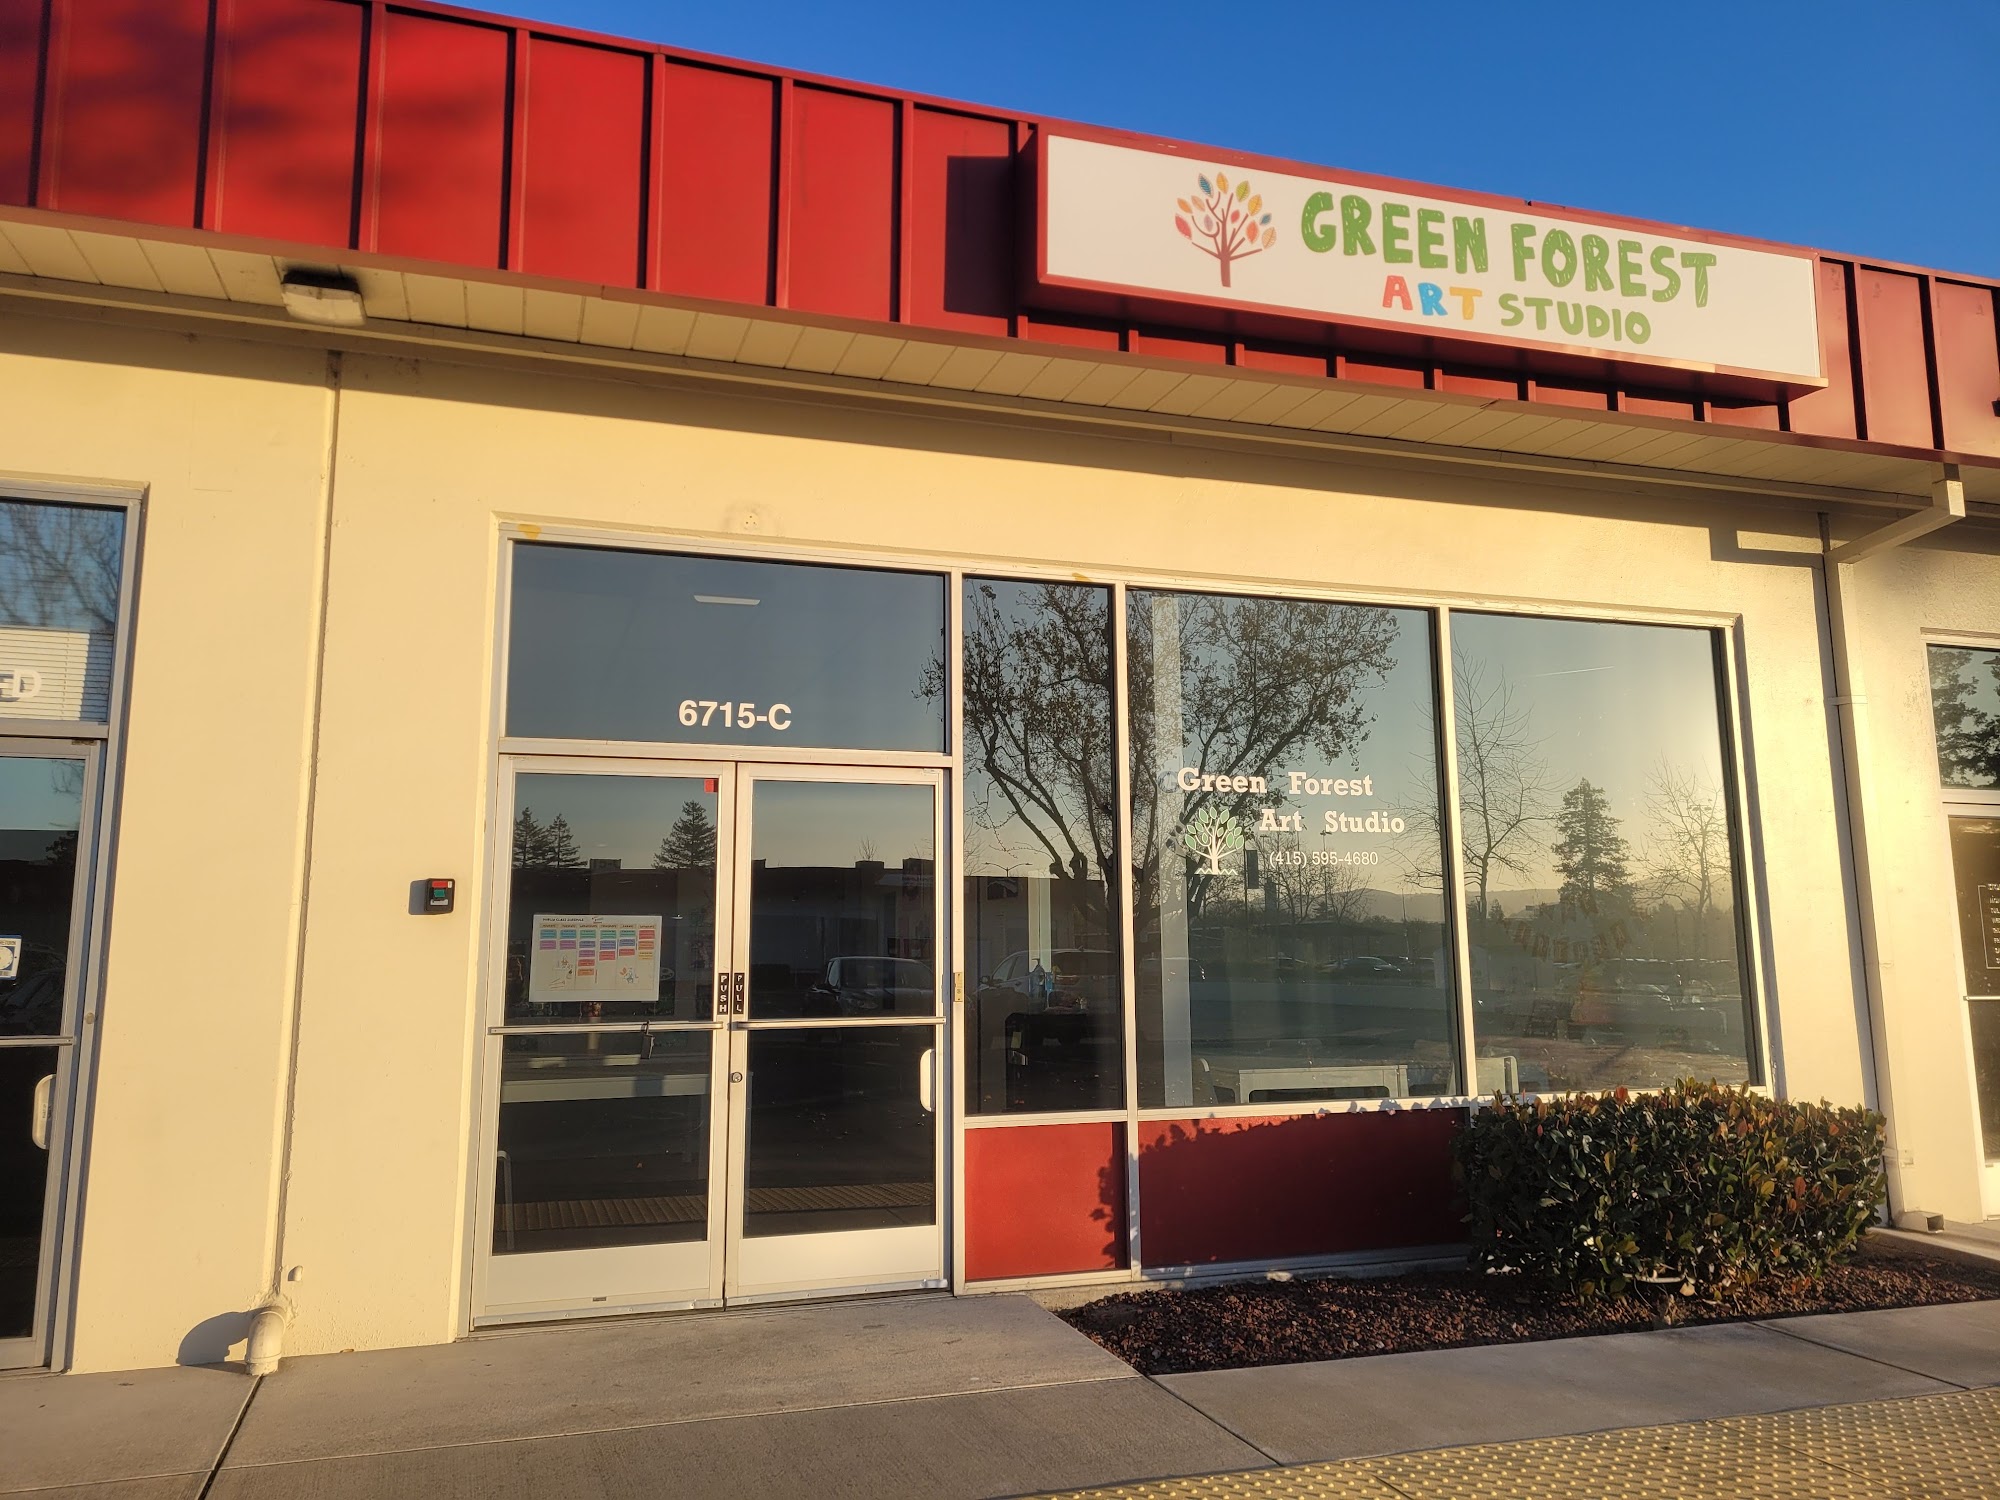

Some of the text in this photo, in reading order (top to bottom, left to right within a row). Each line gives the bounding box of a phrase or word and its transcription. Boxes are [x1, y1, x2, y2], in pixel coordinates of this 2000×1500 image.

[1301, 191, 1717, 308] GREEN FOREST
[1382, 275, 1652, 345] ART STUDIO
[678, 699, 792, 731] 6715-C
[1177, 767, 1374, 796] Green Forest
[1258, 808, 1405, 834] Art Studio
[1269, 851, 1379, 869] (415) 595-4680
[719, 975, 728, 1013] PUSH
[735, 975, 743, 1012] PULL
